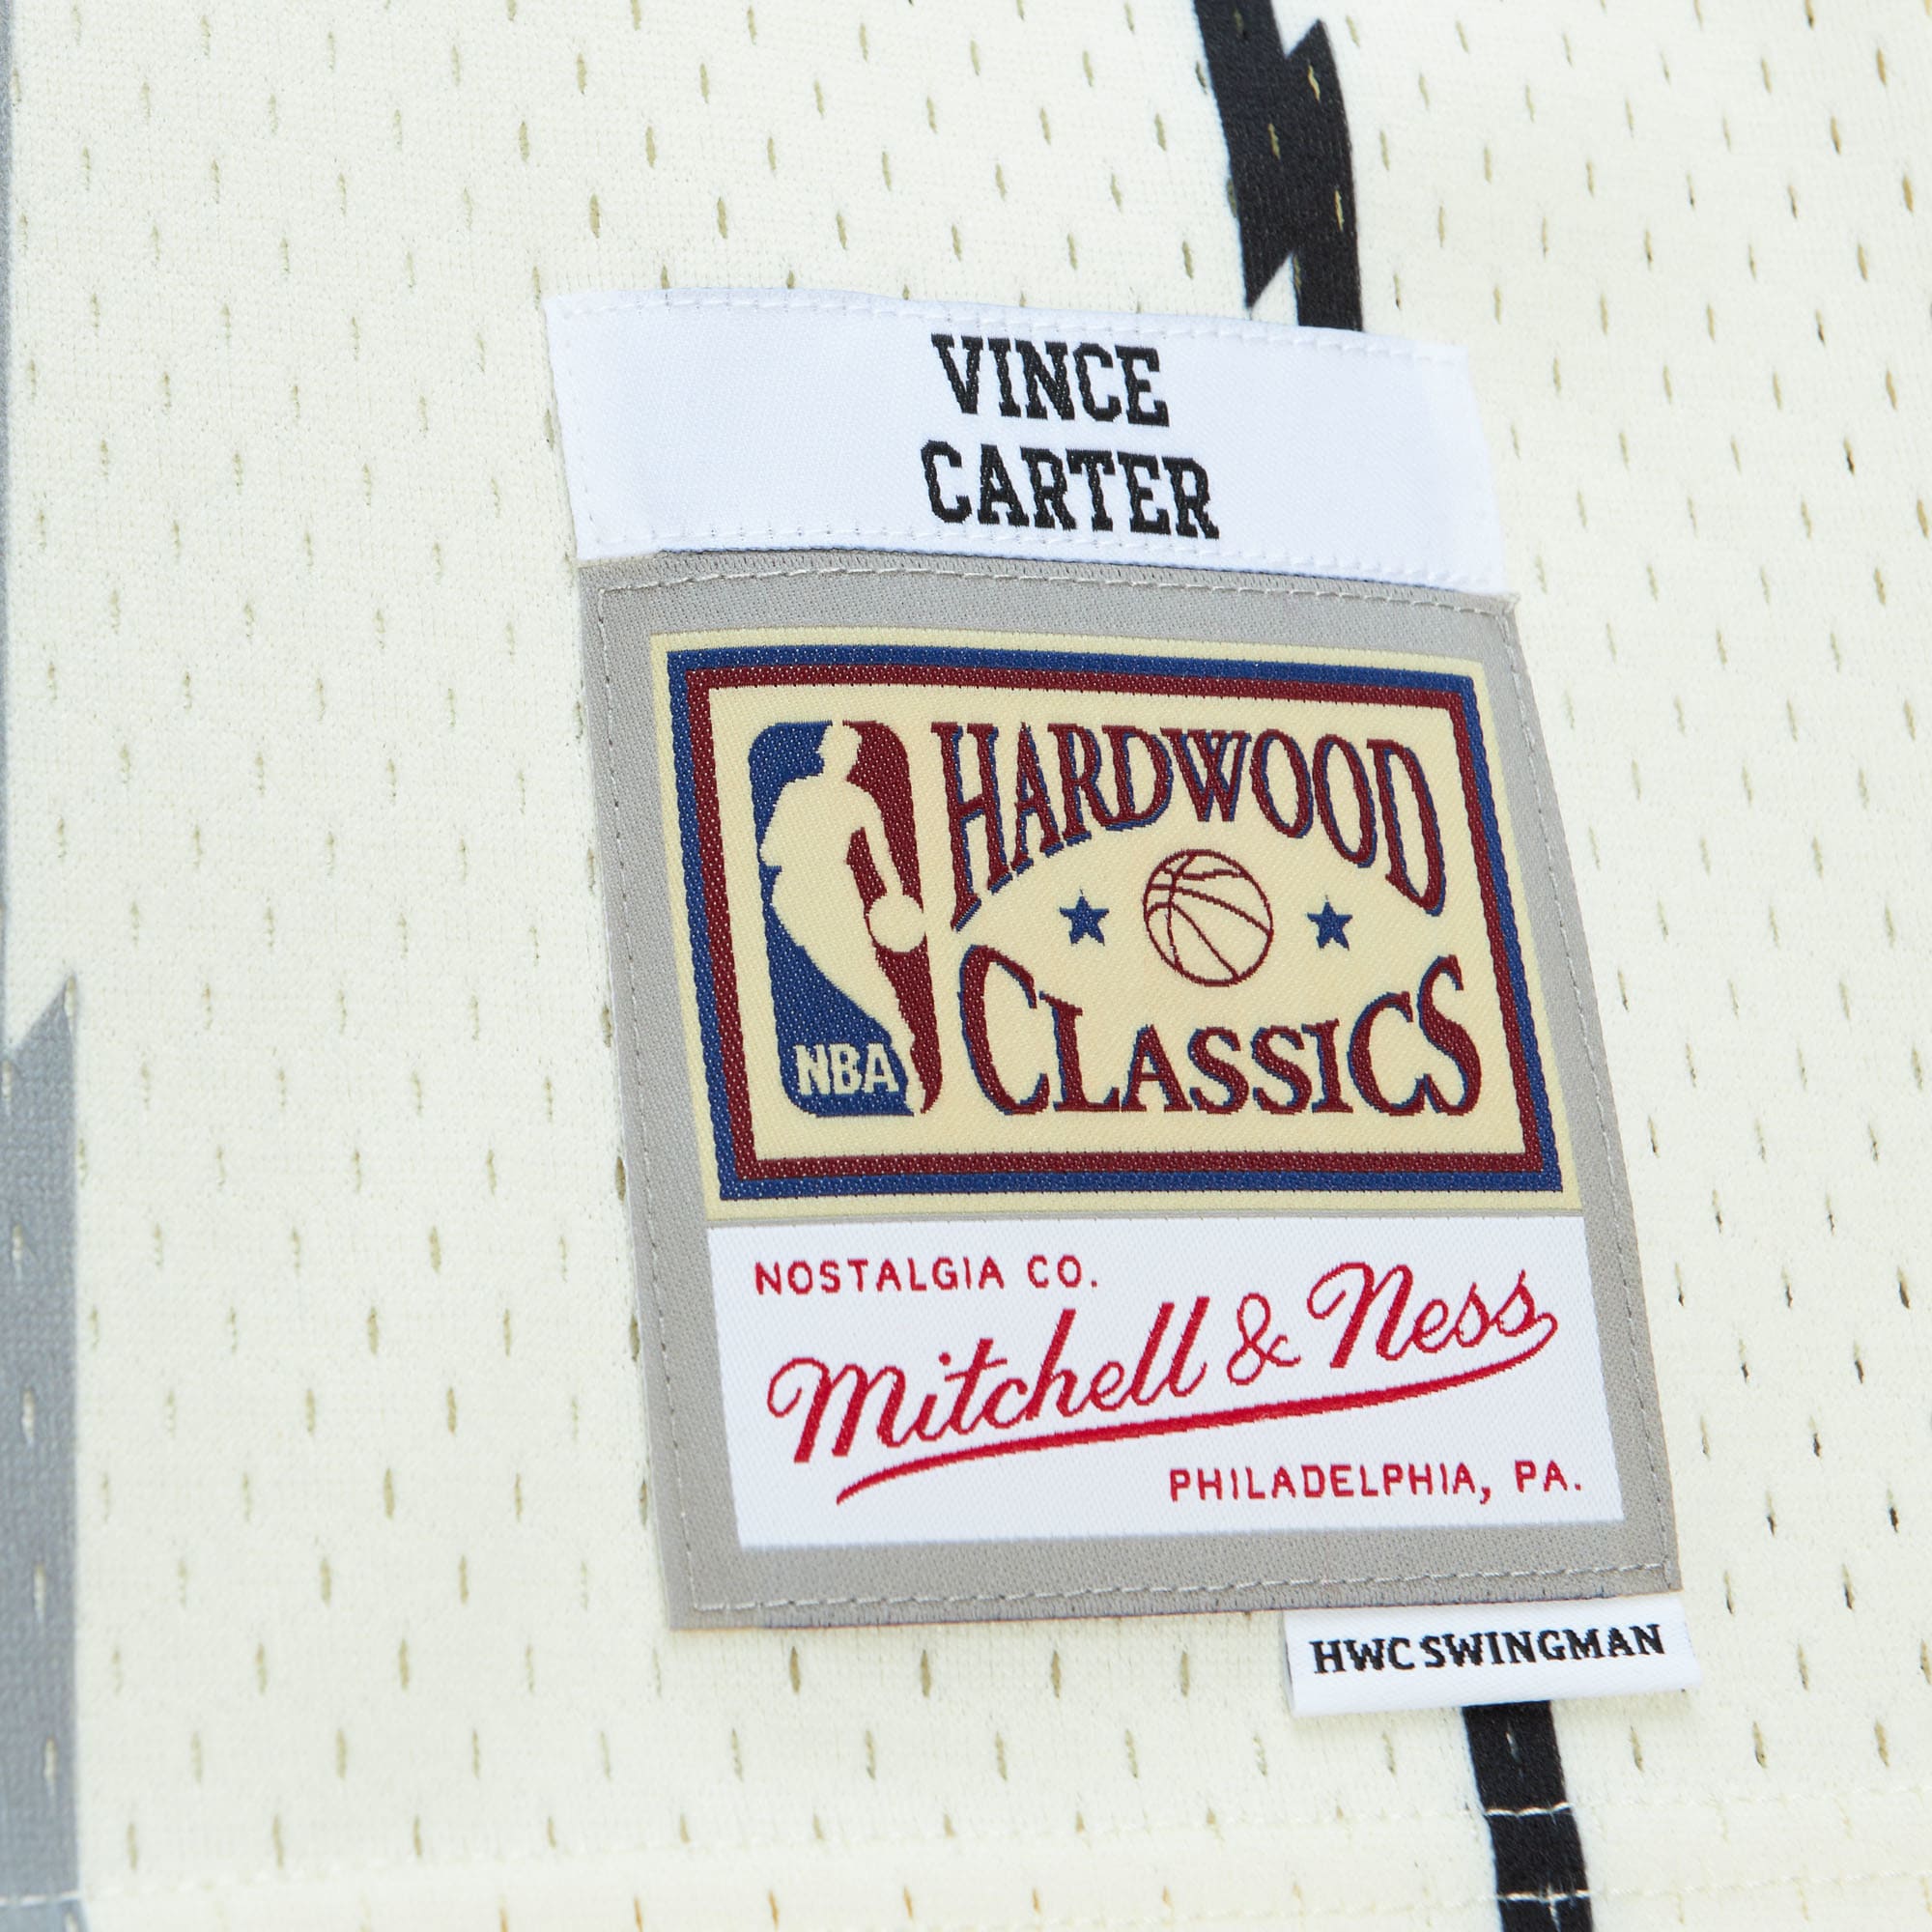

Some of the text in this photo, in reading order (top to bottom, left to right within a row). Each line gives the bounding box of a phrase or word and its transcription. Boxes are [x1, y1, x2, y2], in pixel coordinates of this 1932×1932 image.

[930, 334, 1170, 427] VINCE
[921, 440, 1220, 540] CARTER
[931, 722, 1445, 933] HARDWOOD
[792, 1041, 899, 1097] NBA
[957, 944, 1483, 1117] CLASSICS
[754, 1254, 1098, 1296] NOSTALGIA CO.
[767, 1260, 1558, 1463] Mitchell & Ness
[1169, 1460, 1581, 1505] PHILADELPHIA, PA.
